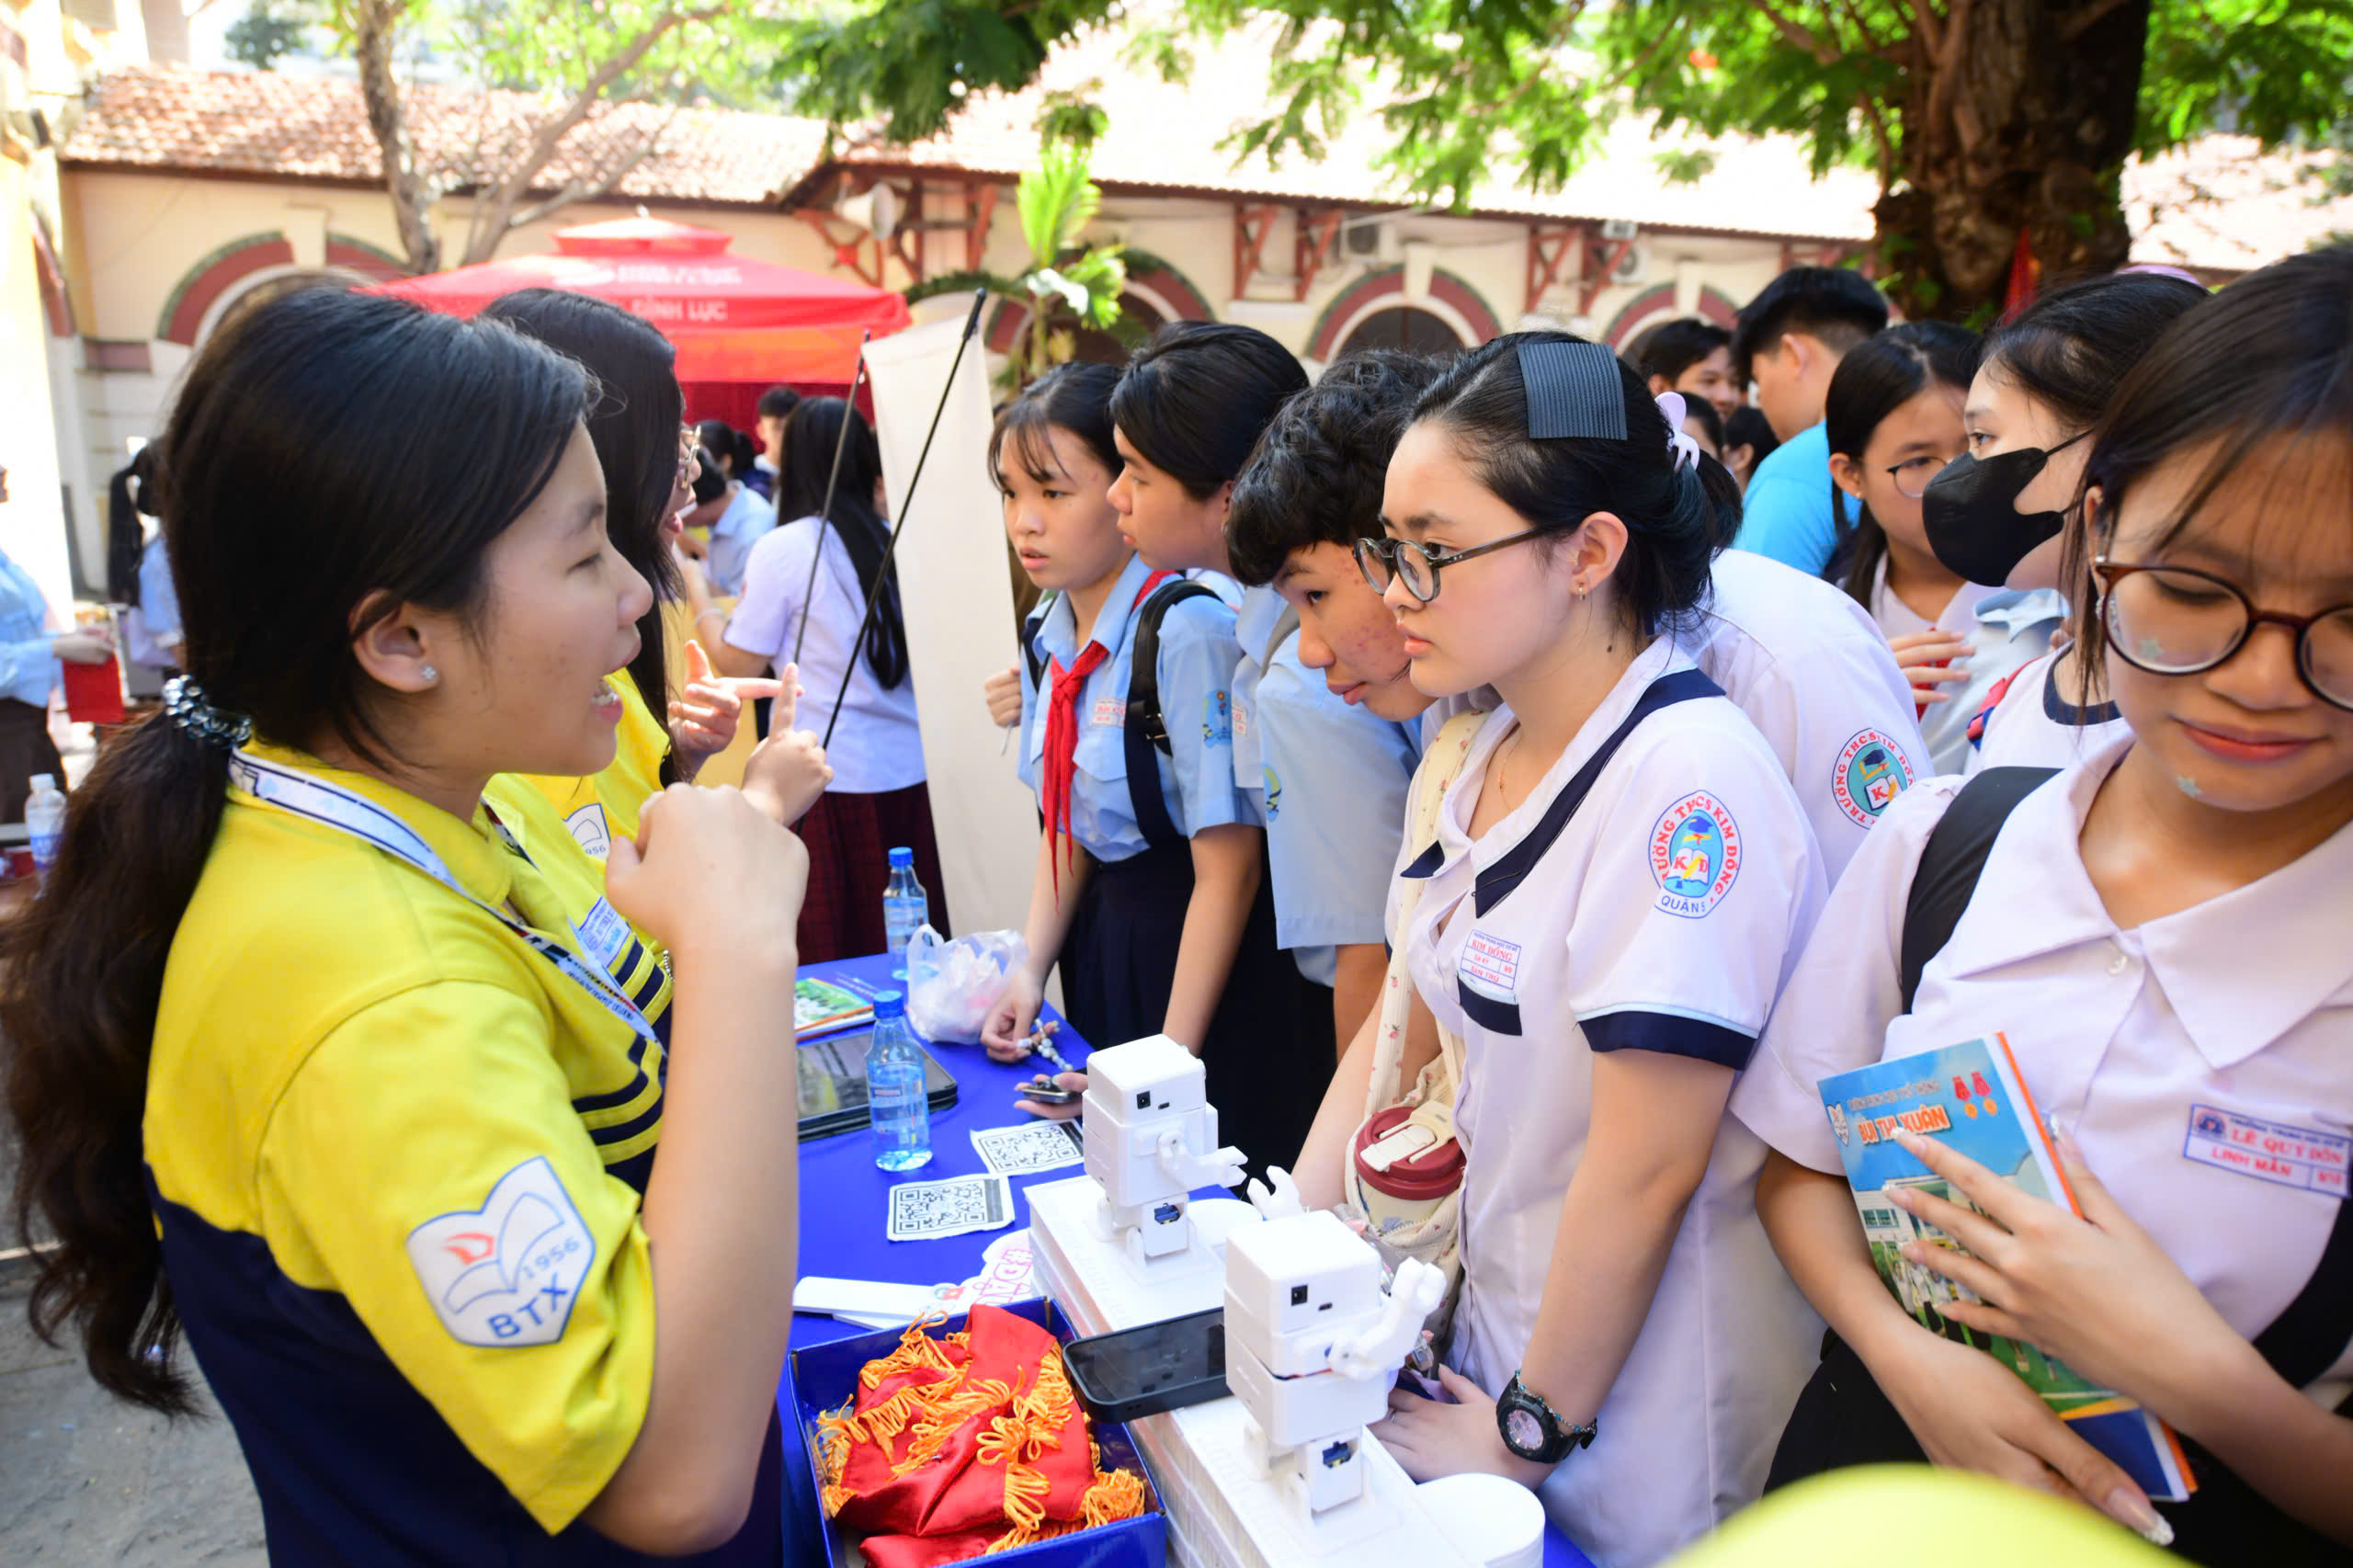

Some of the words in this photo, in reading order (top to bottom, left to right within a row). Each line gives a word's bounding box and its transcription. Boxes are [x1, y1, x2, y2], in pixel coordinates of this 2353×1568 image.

[1844, 732, 1876, 758] THCS
[1871, 785, 1889, 801] K
[1712, 807, 1735, 840] KIM
[585, 845, 607, 856] 956
[1472, 938, 1486, 951] KIM
[1897, 1103, 1950, 1134] XUÂN
[521, 1237, 580, 1280] 1956
[486, 1271, 569, 1339] BTX
